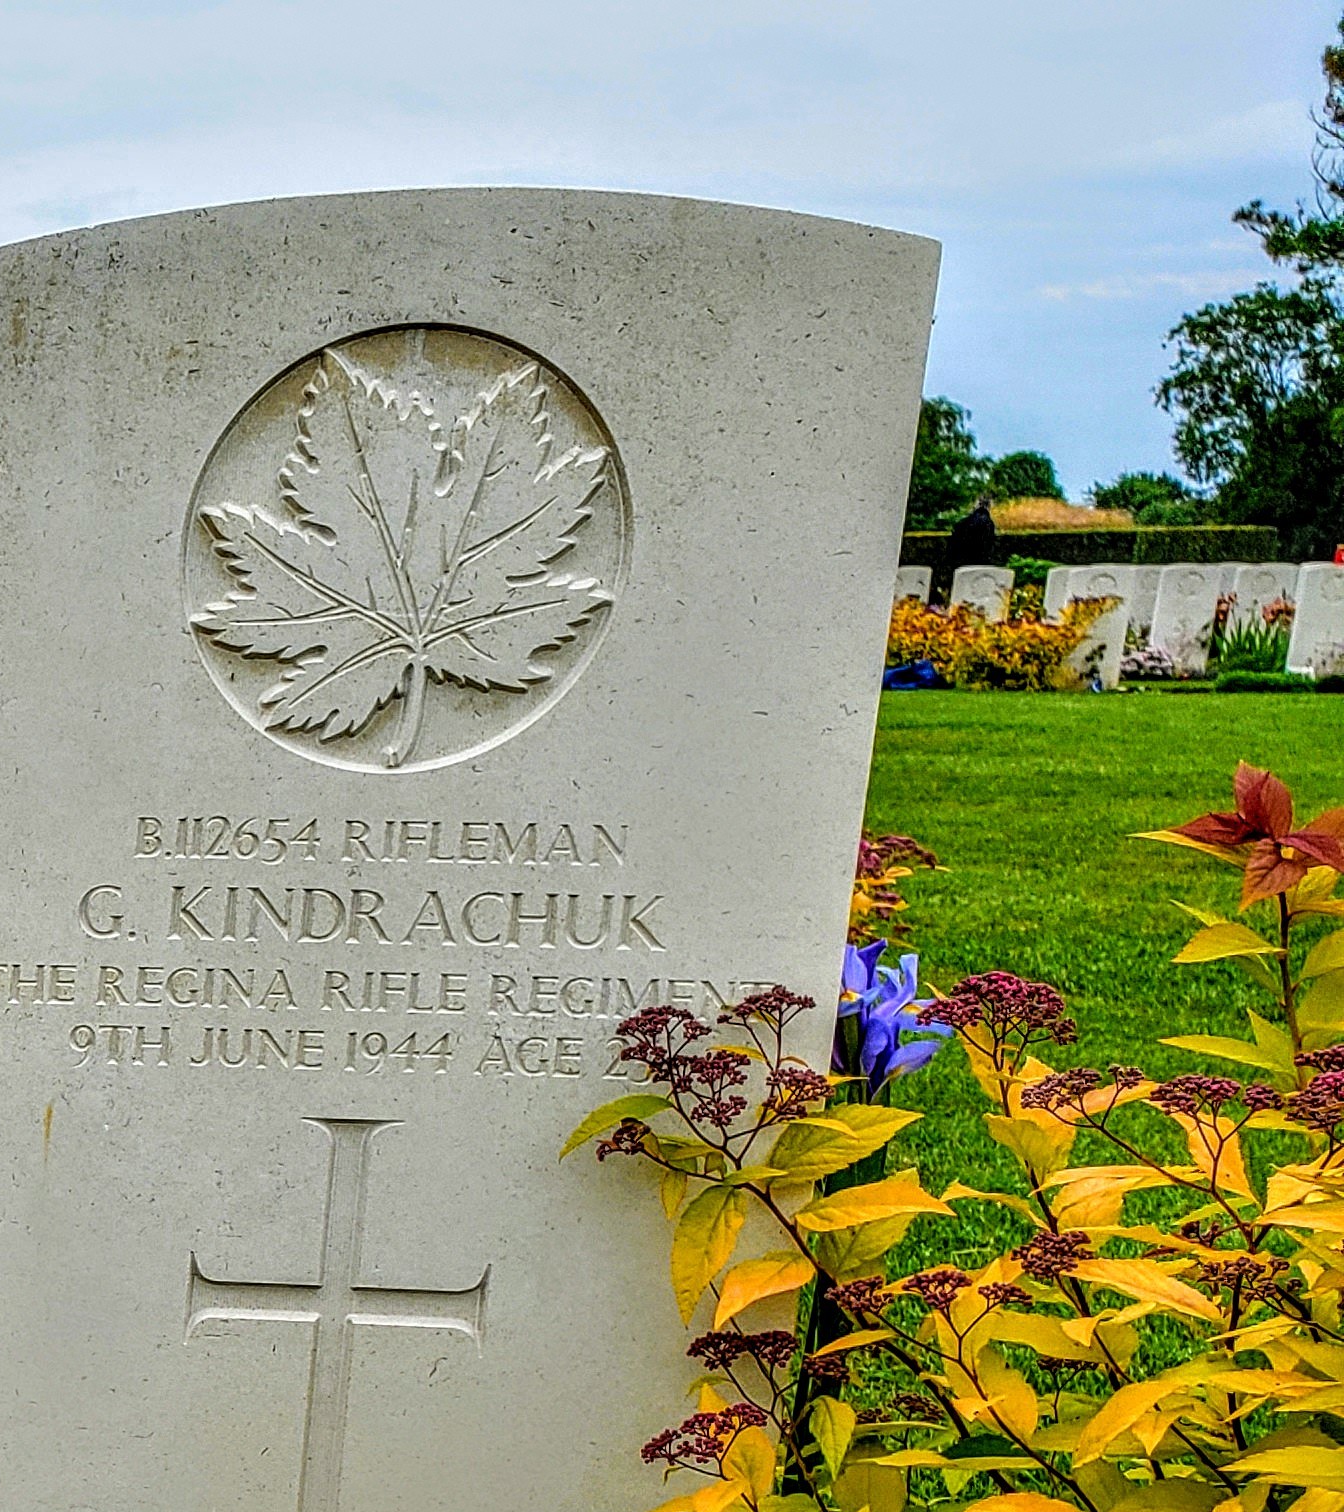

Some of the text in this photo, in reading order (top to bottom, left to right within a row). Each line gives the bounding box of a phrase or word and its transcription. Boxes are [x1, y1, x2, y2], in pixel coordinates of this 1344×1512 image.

[340, 820, 630, 867] RIFLEMAN
[78, 884, 667, 952] G. KINDRACHUK
[95, 965, 300, 1010] REGINA
[319, 971, 468, 1016] RIFLE
[69, 1024, 654, 1086] 9TH JUNE 1944 AGE 2
